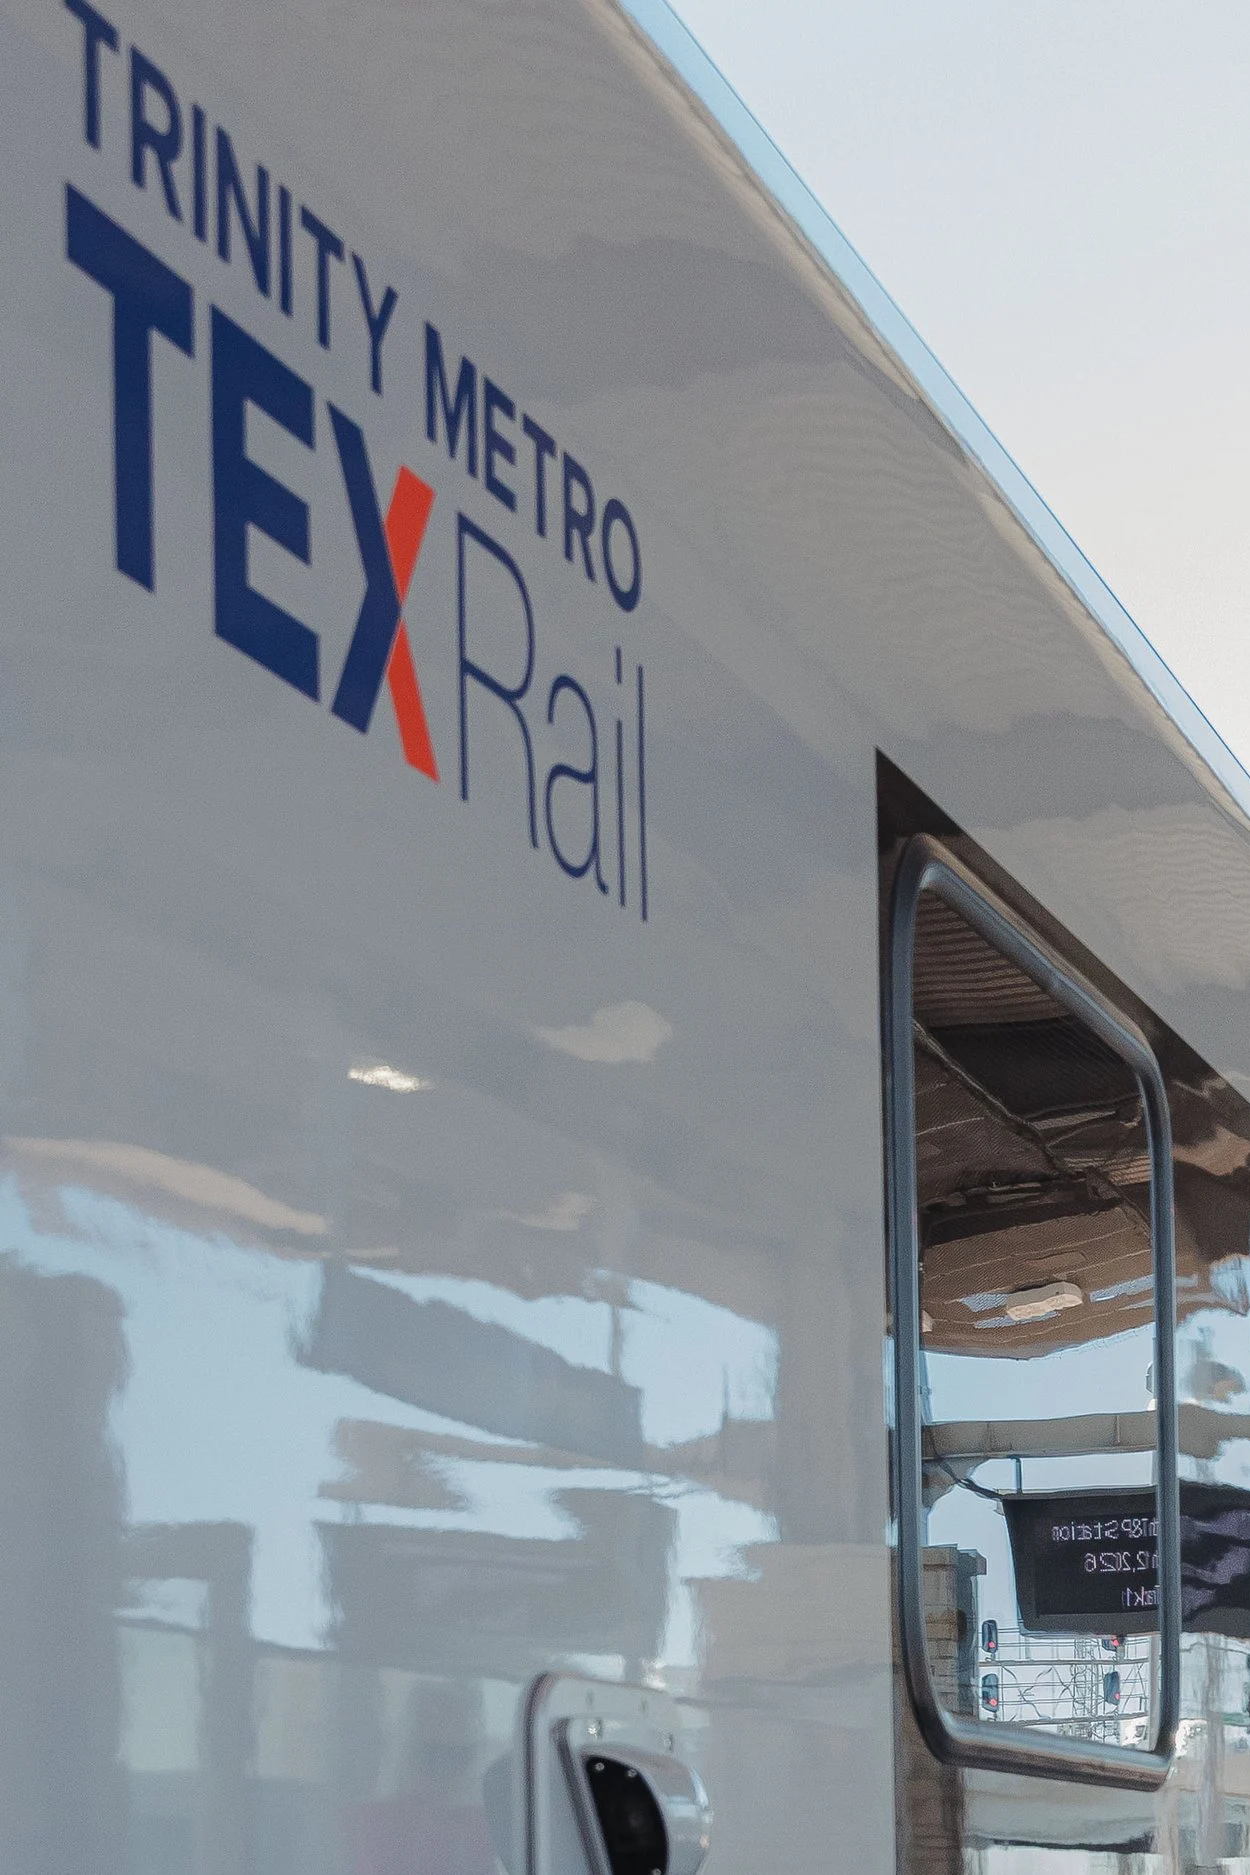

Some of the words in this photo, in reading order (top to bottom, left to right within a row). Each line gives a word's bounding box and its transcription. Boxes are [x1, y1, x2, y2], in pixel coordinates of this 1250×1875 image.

[63, 0, 398, 396] TRINITY
[424, 320, 642, 612] METRO
[65, 181, 648, 922] TEXRail
